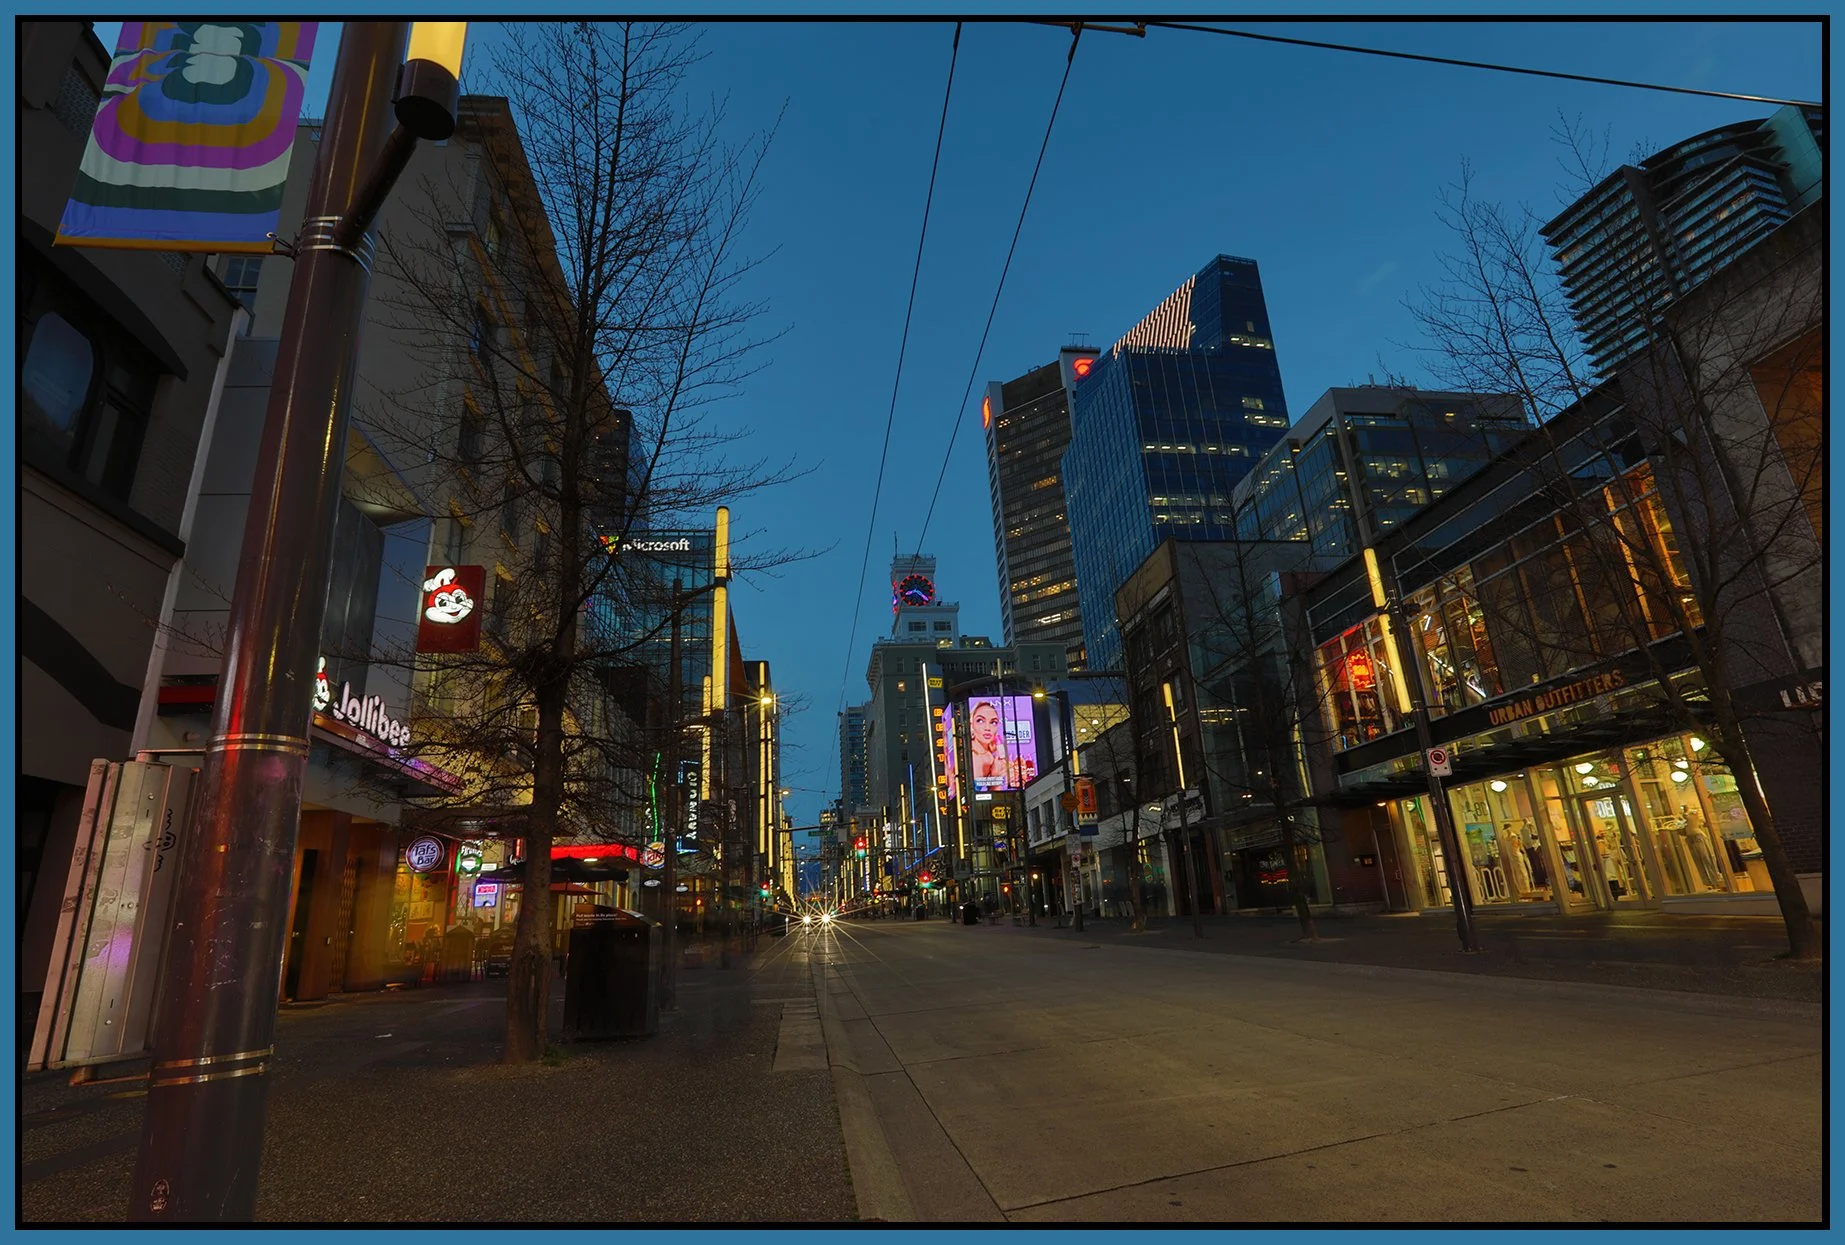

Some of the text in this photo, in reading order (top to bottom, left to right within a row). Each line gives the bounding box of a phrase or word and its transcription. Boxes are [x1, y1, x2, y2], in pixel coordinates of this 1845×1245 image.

[332, 680, 412, 750] Jollibee
[1488, 668, 1625, 726] URBAN OUTFITTERS
[416, 857, 434, 866] Bar
